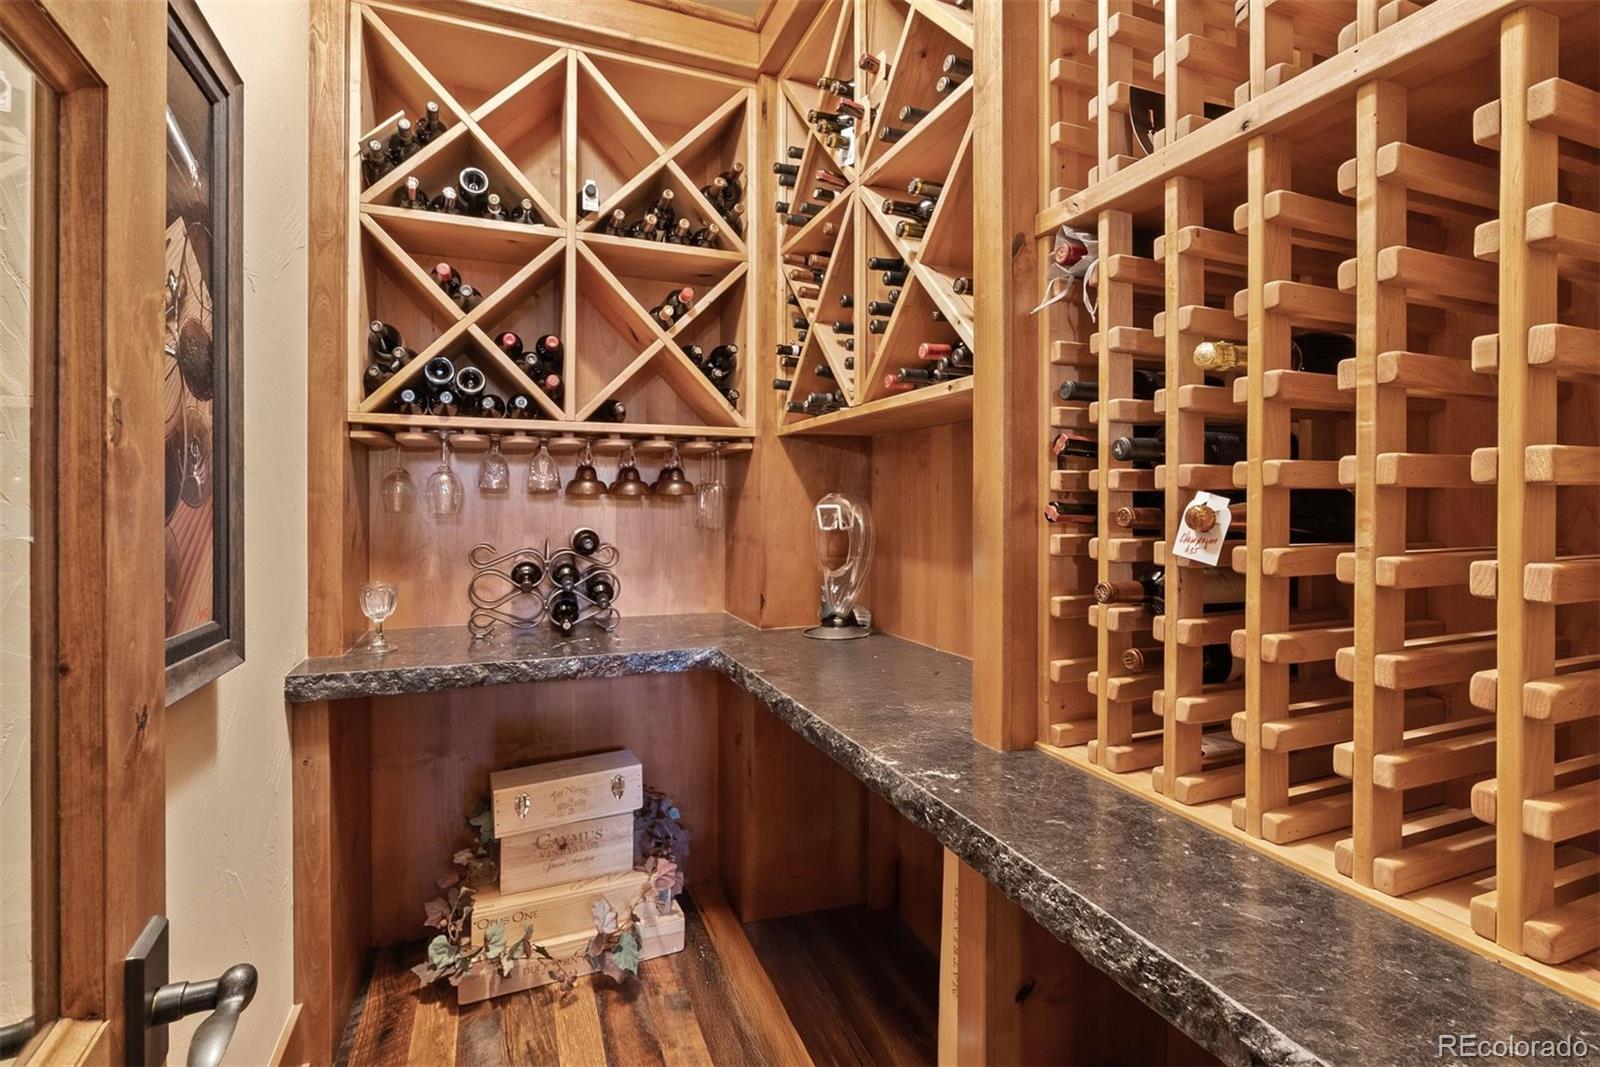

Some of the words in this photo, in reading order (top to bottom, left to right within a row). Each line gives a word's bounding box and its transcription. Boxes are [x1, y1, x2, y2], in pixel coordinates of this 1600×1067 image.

[535, 829, 604, 850] CAYMUS
[477, 916, 510, 930] OPUS
[512, 911, 540, 922] ONE
